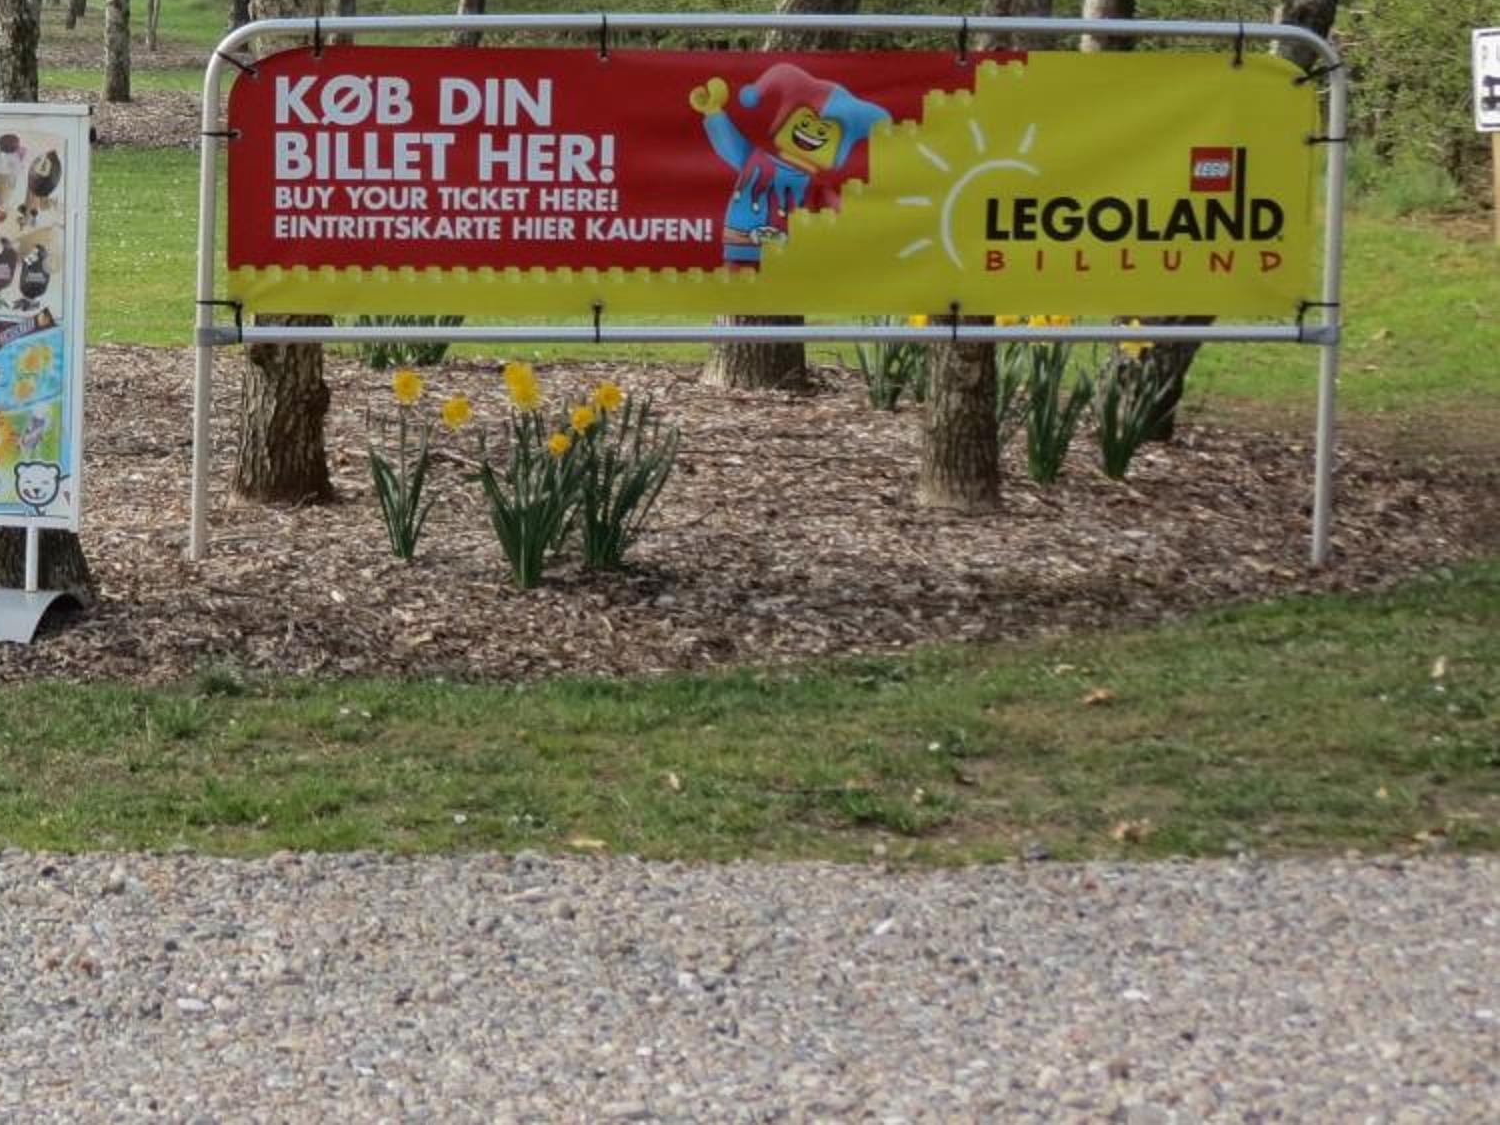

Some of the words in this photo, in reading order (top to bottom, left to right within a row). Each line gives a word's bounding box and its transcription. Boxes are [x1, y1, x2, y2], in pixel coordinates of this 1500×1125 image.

[275, 74, 413, 127] KØB
[439, 77, 553, 127] DIN
[275, 131, 456, 181] BILLET
[478, 133, 616, 184] HER!
[1193, 160, 1230, 178] LEGO
[275, 186, 332, 210] BUY
[345, 186, 429, 211] YOUR
[437, 186, 530, 211] TICKET
[539, 188, 619, 212] HERE!
[985, 146, 1285, 243] LEGOLAND
[275, 215, 501, 240] EINTRITTSKARTE
[512, 216, 576, 241] HIER
[585, 217, 713, 243] KAUFEN!
[985, 250, 1282, 273] BILLUND
